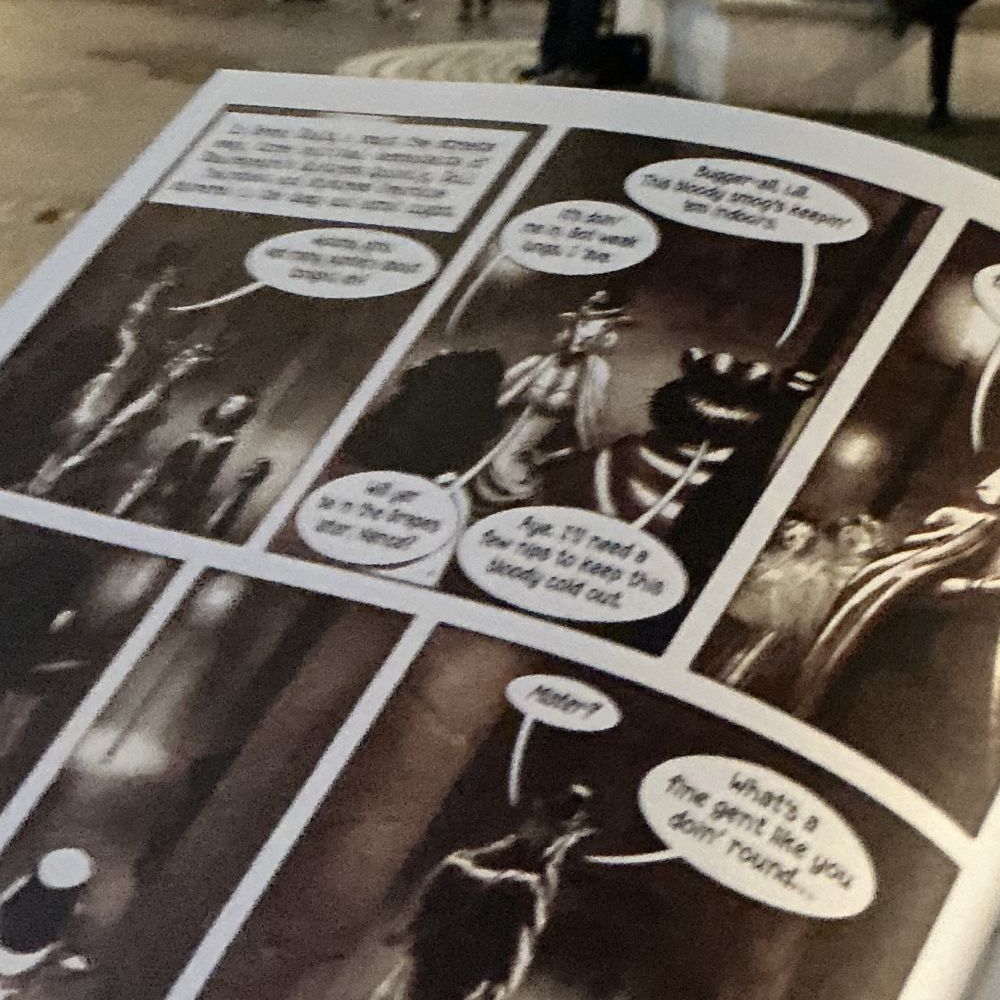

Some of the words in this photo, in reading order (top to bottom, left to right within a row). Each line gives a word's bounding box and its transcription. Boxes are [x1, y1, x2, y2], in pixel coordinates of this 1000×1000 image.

[664, 773, 713, 809] fine
[710, 800, 768, 837] gent
[768, 825, 809, 860] like
[810, 854, 855, 891] you
[803, 814, 820, 834] a
